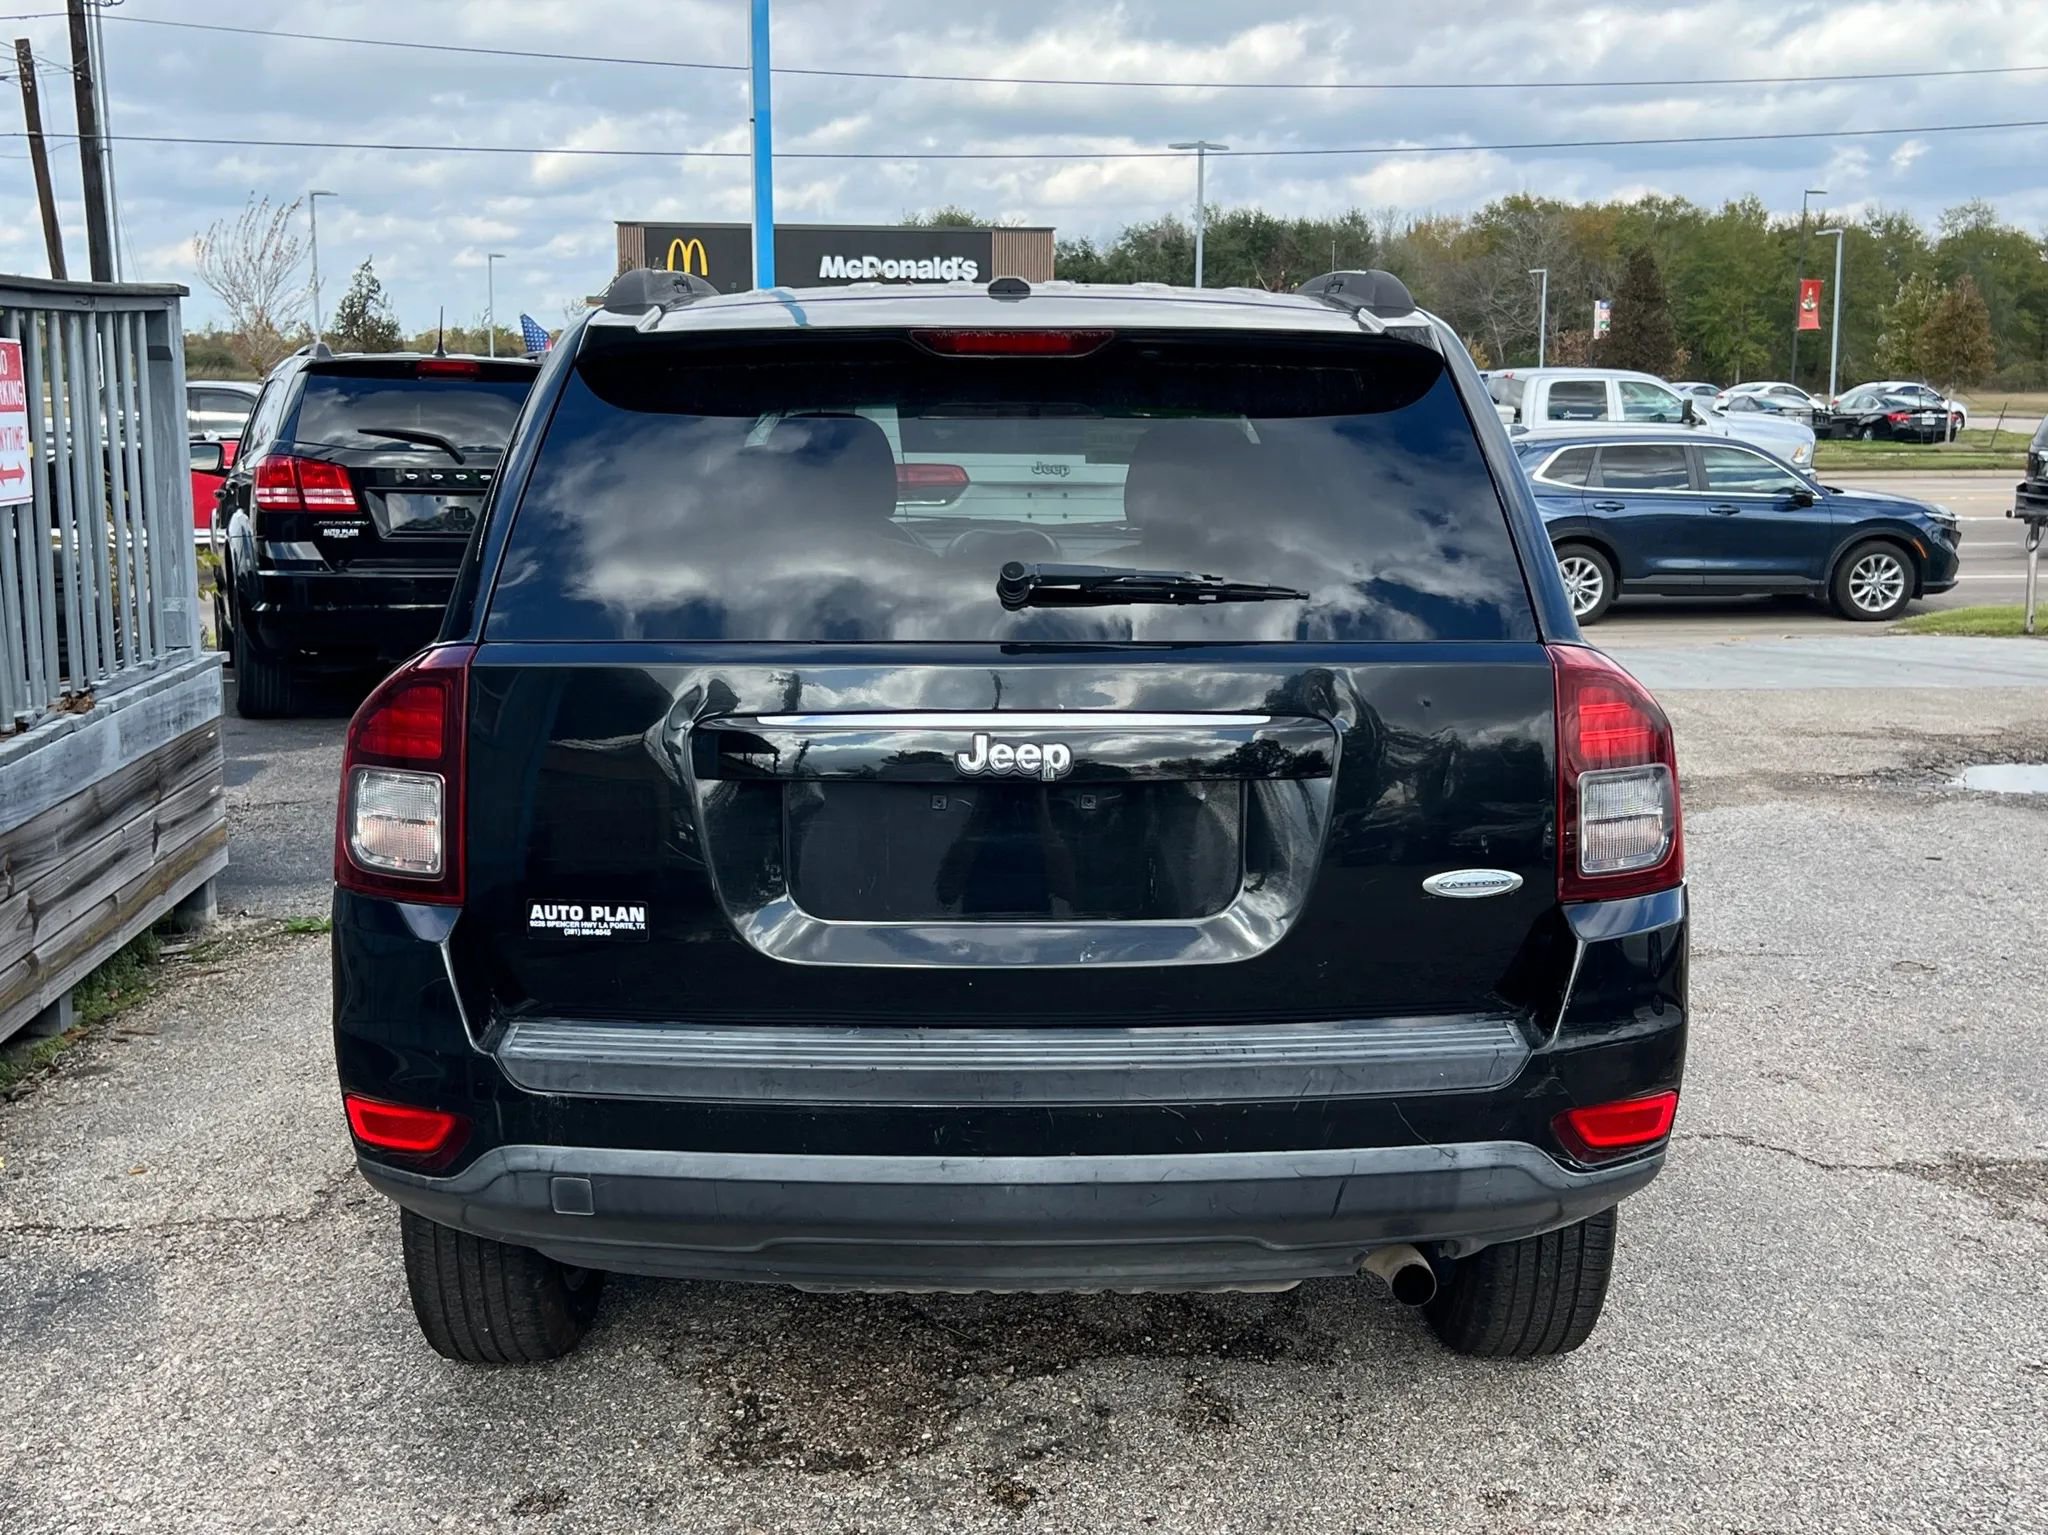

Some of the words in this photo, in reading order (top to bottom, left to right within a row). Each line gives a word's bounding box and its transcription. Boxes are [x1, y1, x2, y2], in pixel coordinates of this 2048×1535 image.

[818, 255, 978, 280] McDonald's
[1031, 461, 1070, 477] Jeep
[955, 733, 1073, 781] Jeep
[530, 904, 584, 920] AUTO
[591, 906, 645, 921] PLAN
[546, 920, 580, 928] SPENCER
[580, 921, 598, 929] HWY
[598, 921, 609, 929] LA
